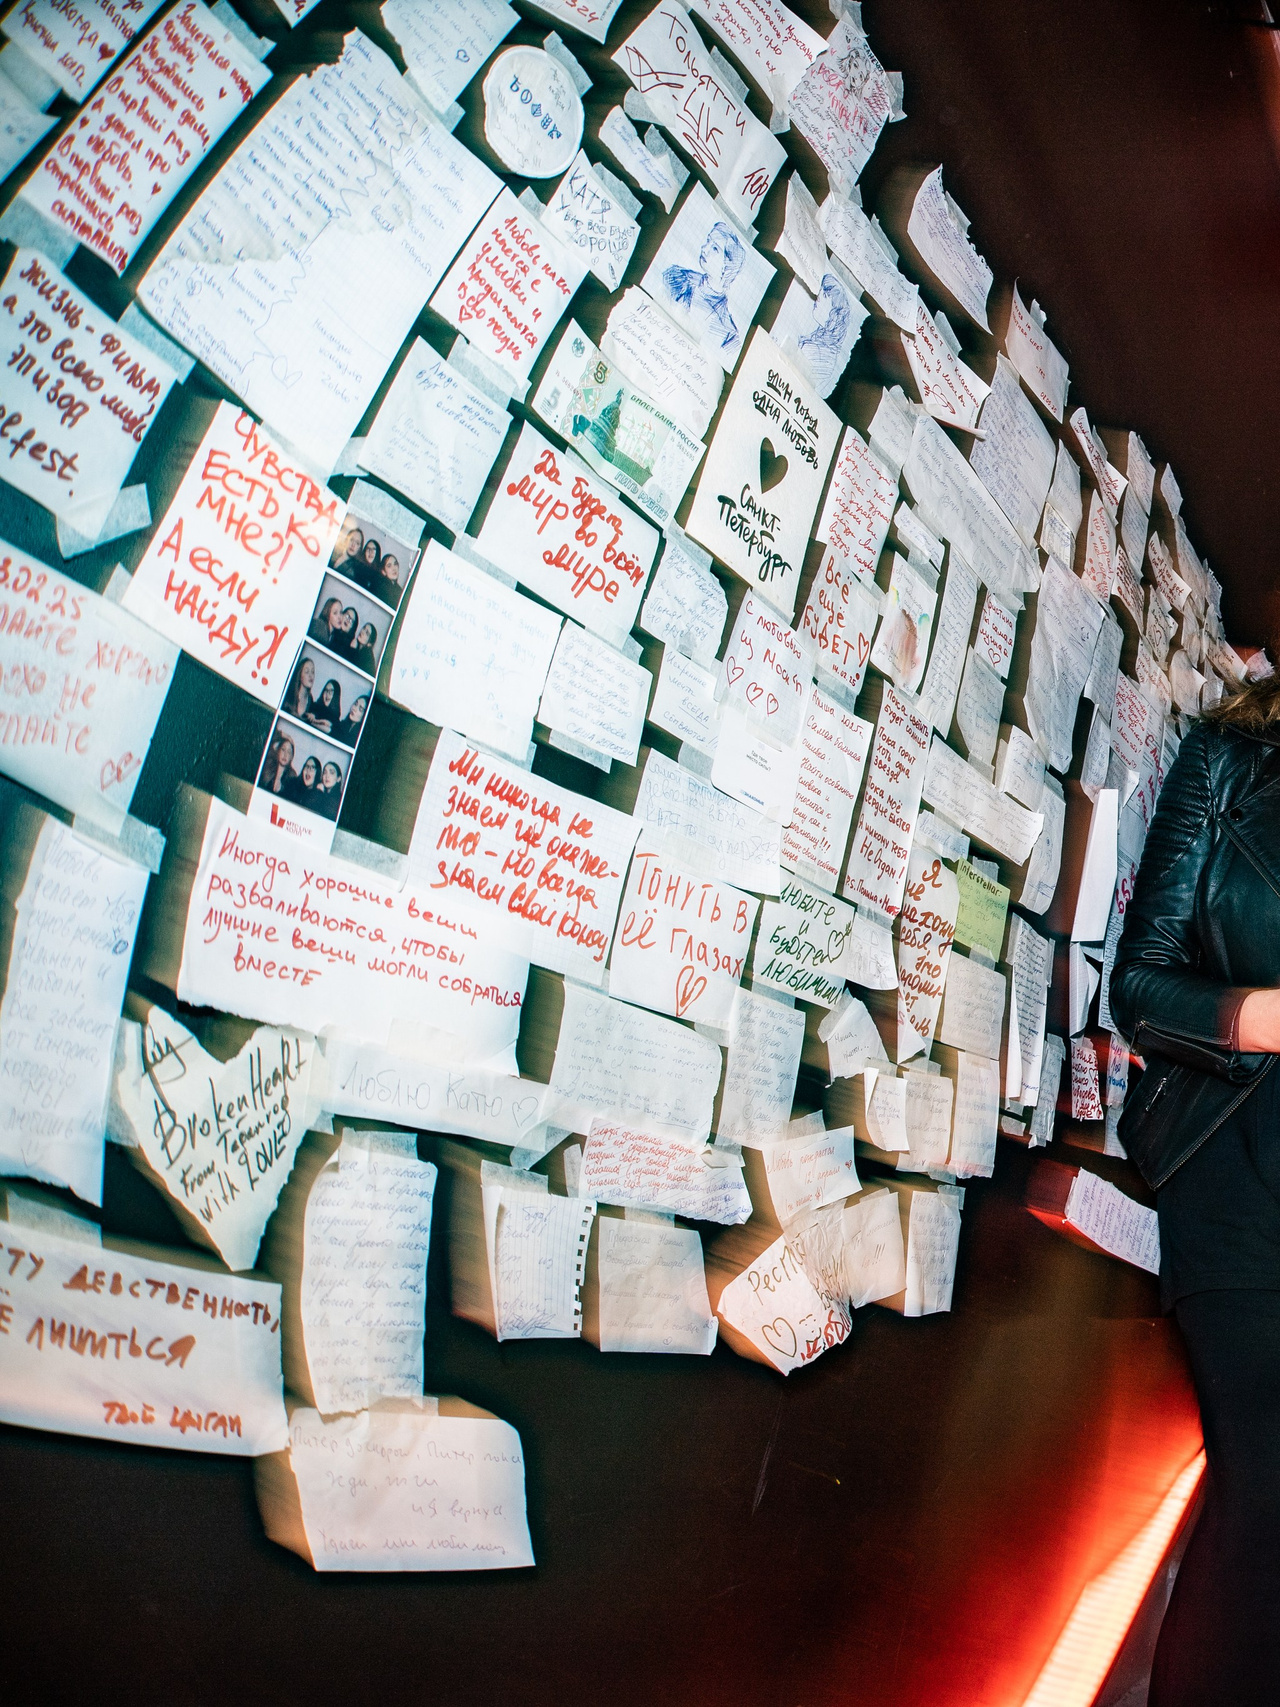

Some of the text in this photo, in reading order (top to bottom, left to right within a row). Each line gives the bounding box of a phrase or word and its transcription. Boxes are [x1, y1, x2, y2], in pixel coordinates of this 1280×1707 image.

[654, 409, 677, 431] БАНКА
[677, 428, 700, 453] РОССИИ
[202, 448, 279, 518] ЕСТЬ
[614, 471, 670, 523] ПЯТЬ РУБЛЕЙ
[158, 517, 183, 562] А
[218, 828, 291, 892] Иногда
[299, 868, 394, 909] хорошие
[341, 1060, 431, 1110] Люблю
